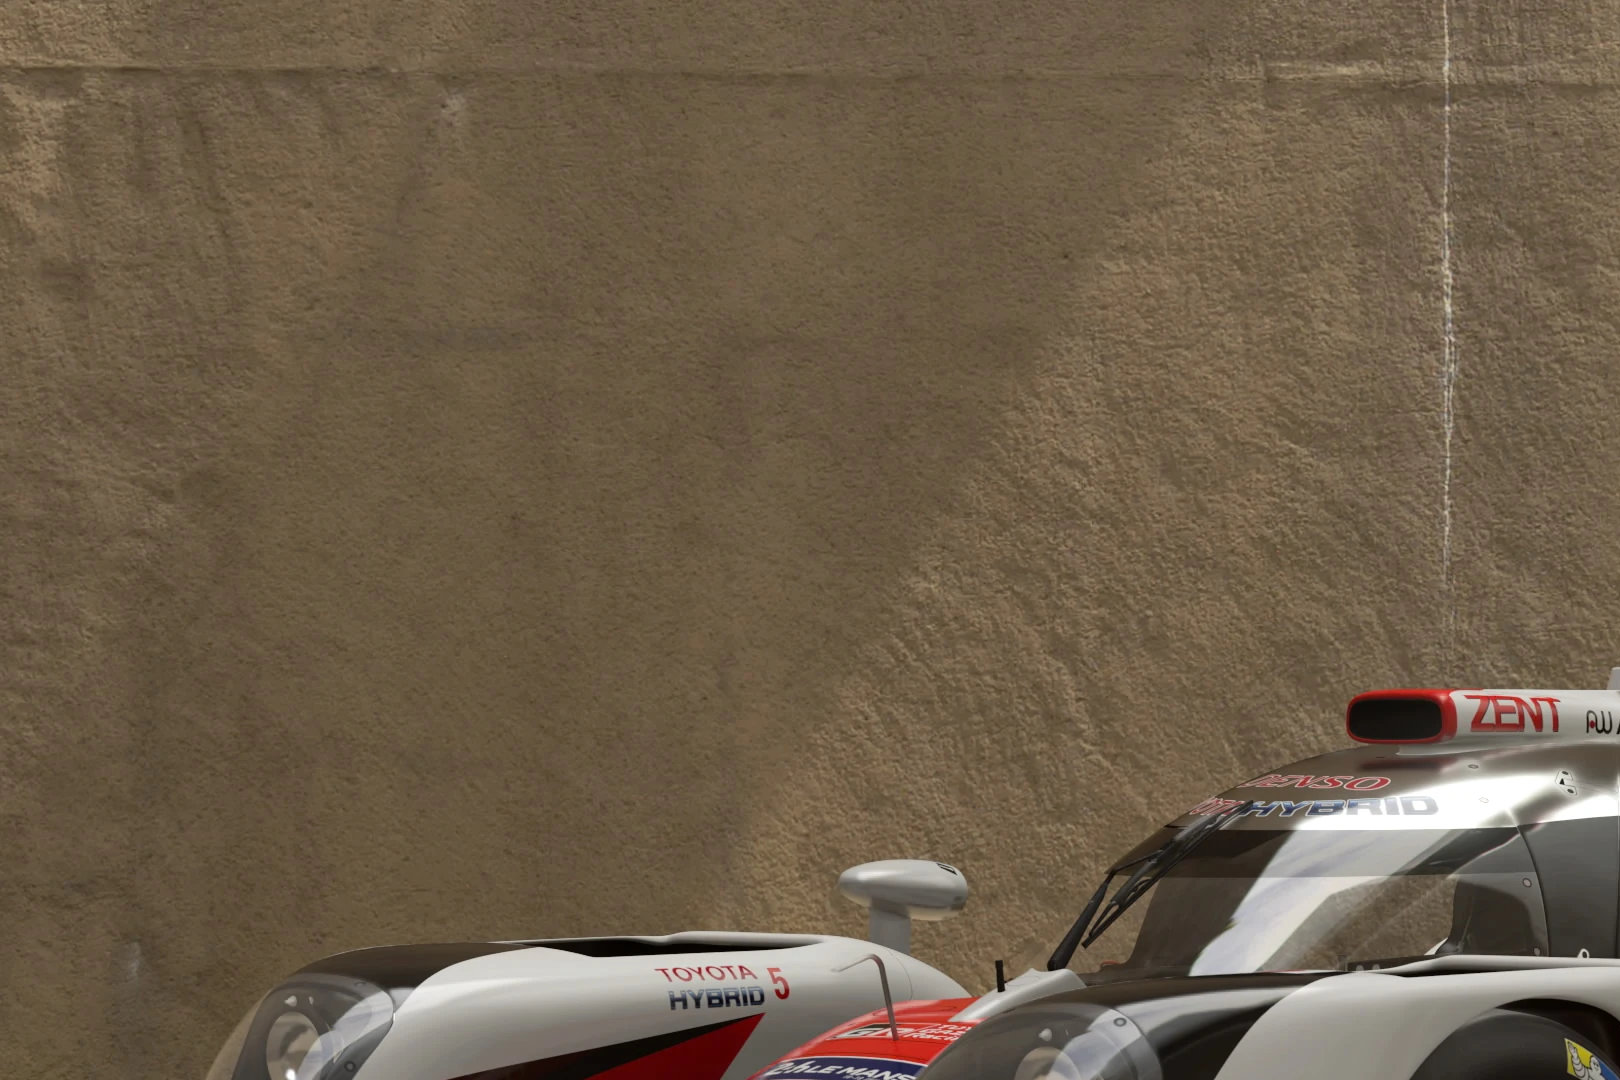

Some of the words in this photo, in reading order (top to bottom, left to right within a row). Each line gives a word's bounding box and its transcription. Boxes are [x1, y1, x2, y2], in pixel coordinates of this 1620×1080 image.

[1463, 695, 1561, 733] ZENT
[1242, 796, 1439, 818] HYBRID
[654, 965, 758, 983] TOYOTA
[767, 967, 790, 1000] 5
[667, 986, 765, 1010] HYBRID
[810, 1065, 843, 1075] LE
